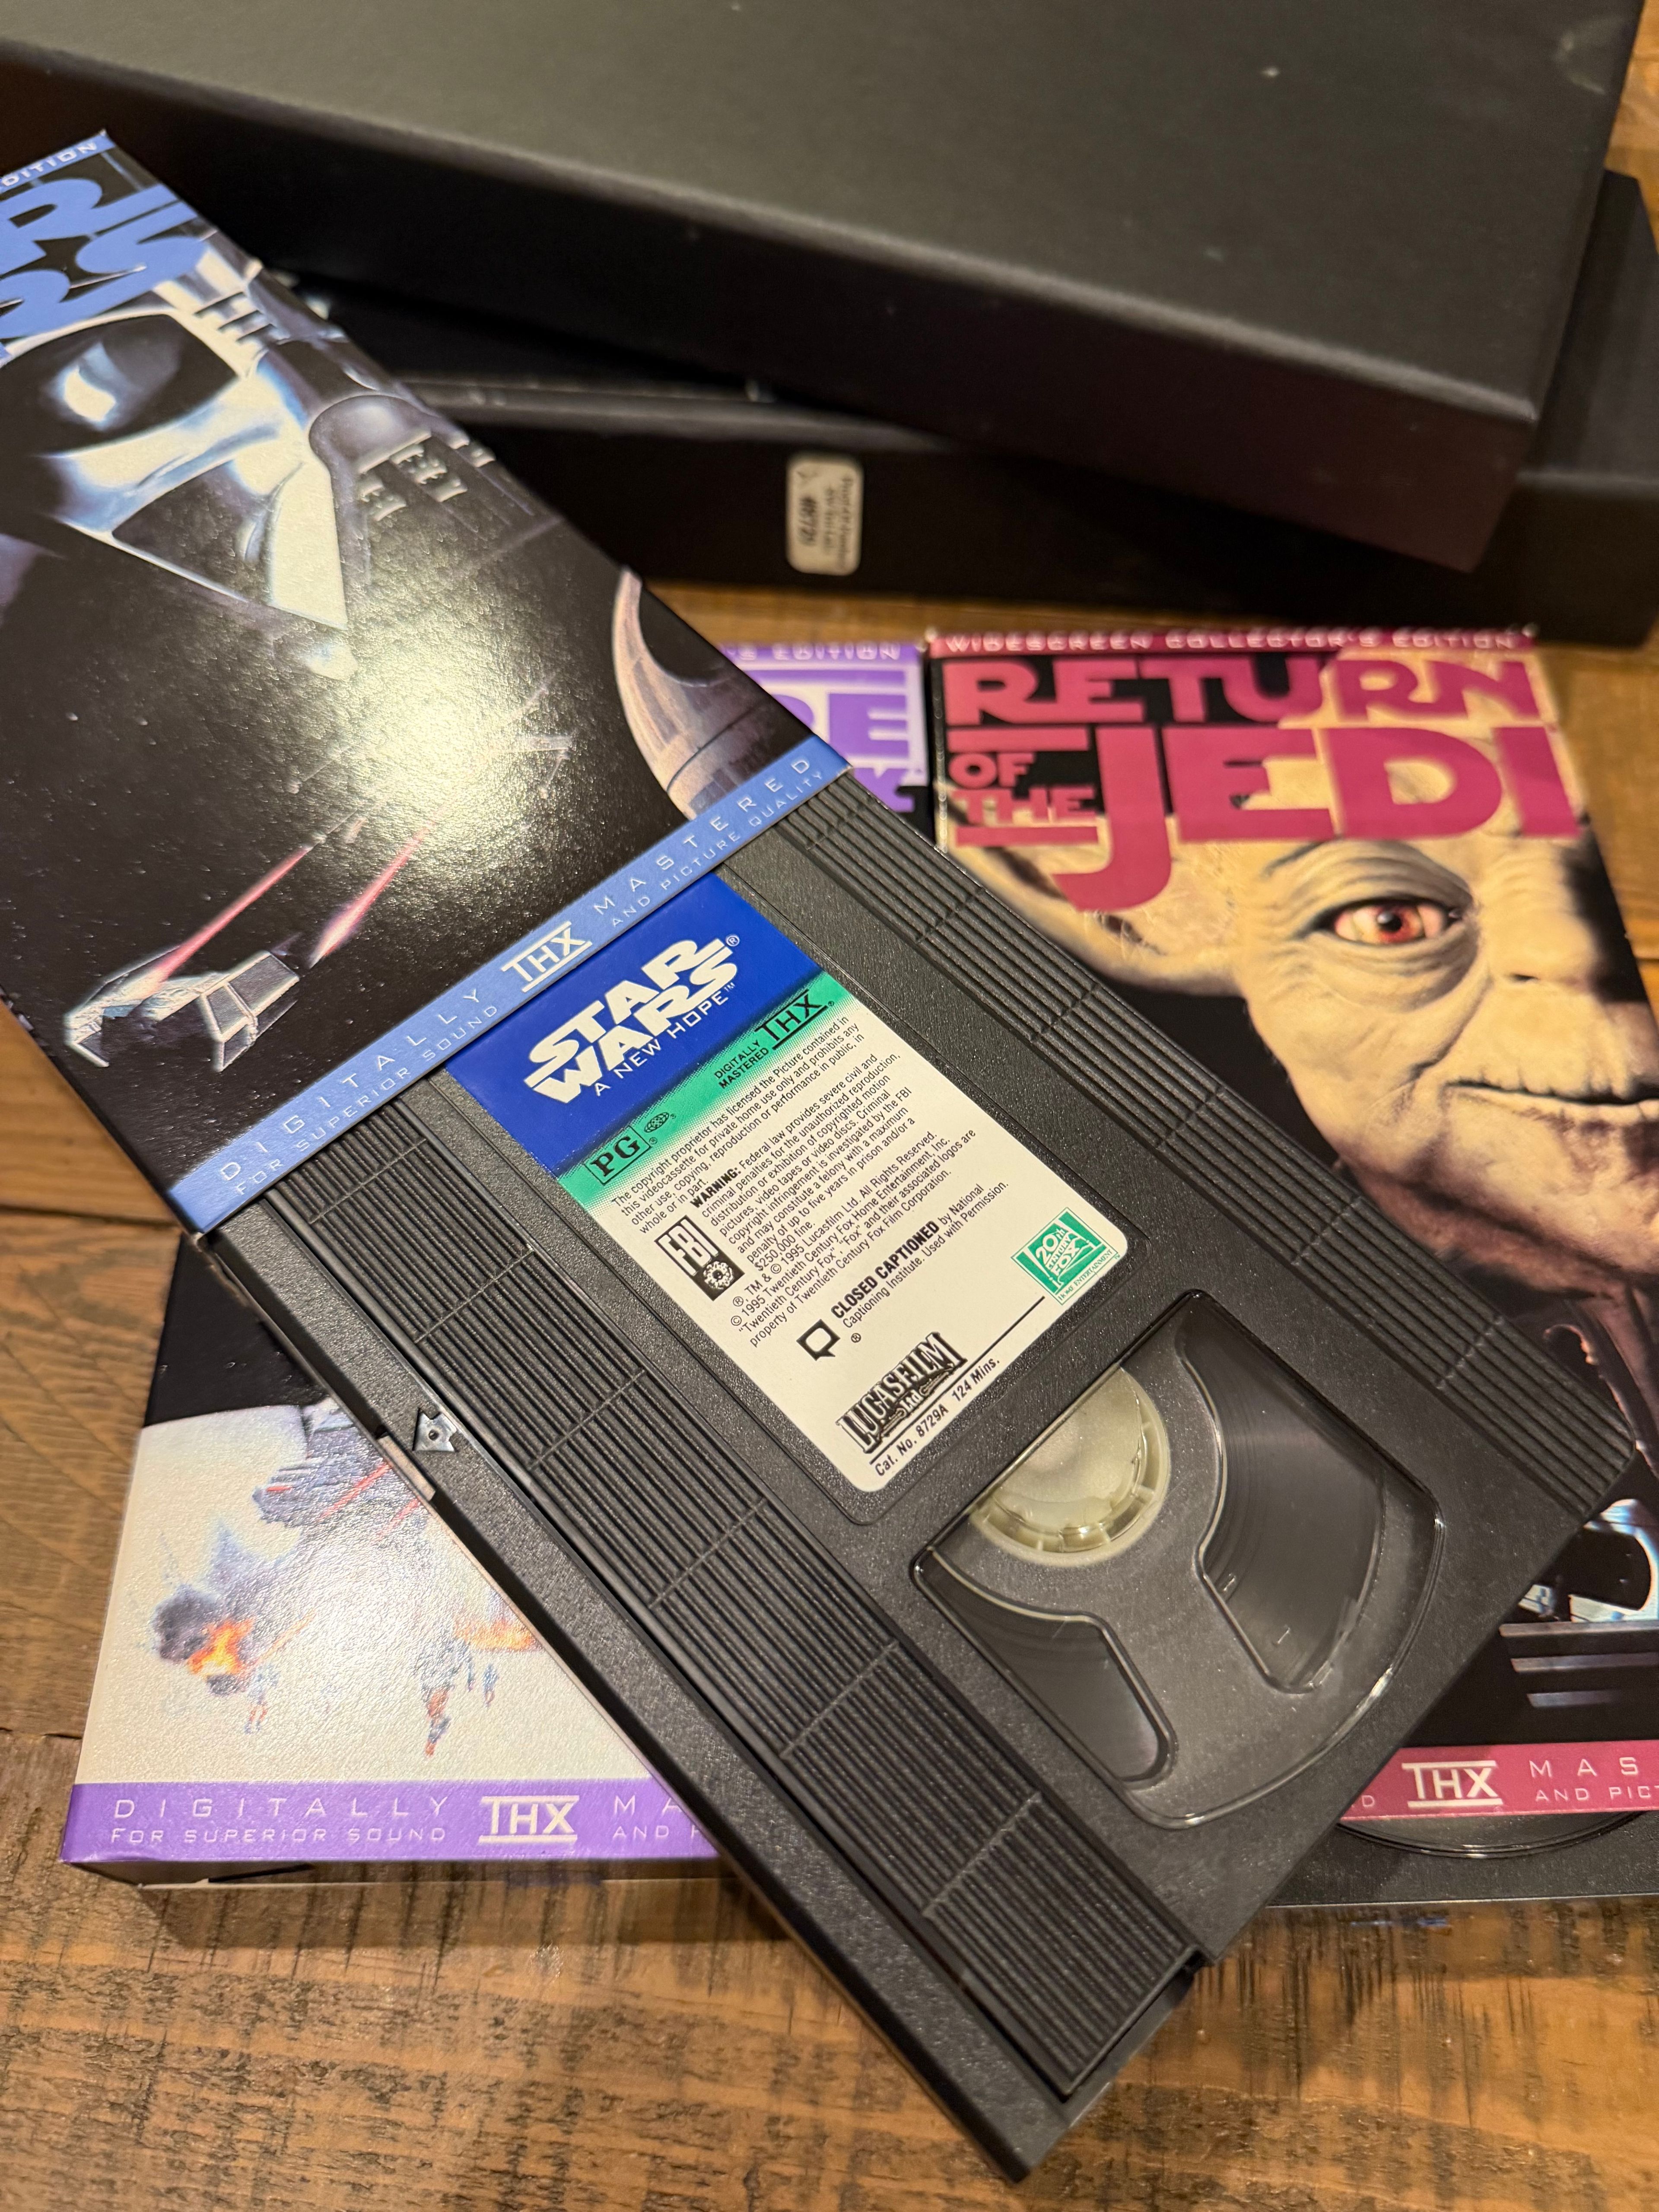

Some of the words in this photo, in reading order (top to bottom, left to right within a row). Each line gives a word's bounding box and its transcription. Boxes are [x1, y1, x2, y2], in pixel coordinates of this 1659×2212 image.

[943, 657, 1544, 726] RETURN
[946, 632, 1153, 652] WIDESCREEN
[1392, 629, 1516, 651] EDITION
[948, 752, 1034, 789] OF
[952, 785, 1097, 825] THE
[1052, 726, 1583, 911] JEDI
[220, 989, 479, 1181] DIGITALLY
[501, 921, 592, 993] THX
[593, 760, 811, 915] MASTERED
[235, 1158, 283, 1195] FOR
[296, 1067, 411, 1152] SUPERIOR
[422, 1005, 498, 1062] SOUND
[610, 896, 651, 928] AND
[659, 833, 741, 890] PICTURE
[748, 771, 823, 828] QUALITY
[523, 938, 725, 1088] STAR
[533, 946, 737, 1103] WARS
[753, 988, 828, 1050] THX
[594, 1082, 610, 1096] A
[613, 1039, 661, 1078] NEW
[610, 1192, 632, 1207] The
[630, 1158, 672, 1193] copyright
[670, 1125, 712, 1163] proprietor
[709, 1113, 728, 1128] has
[725, 1084, 762, 1116] licensed
[758, 1075, 775, 1089] the
[772, 1053, 804, 1078] Picture
[802, 1021, 840, 1055] contained
[836, 1017, 849, 1026] in
[621, 1200, 640, 1216] this
[639, 1155, 696, 1201] videocassette
[693, 1143, 709, 1157] for
[708, 1121, 738, 1148] private
[734, 1102, 762, 1124] home
[760, 1090, 777, 1104] use
[775, 1074, 795, 1092] only
[793, 1061, 810, 1077] and
[809, 1035, 844, 1066] prohibits
[842, 1023, 859, 1037] any
[714, 1040, 760, 1079] DIGITALLY
[718, 1048, 769, 1088] MASTERED
[590, 1136, 640, 1177] PG
[631, 1203, 655, 1225] other
[655, 1191, 676, 1206] use,
[674, 1161, 712, 1191] copying,
[709, 1118, 762, 1162] reproduction
[760, 1108, 771, 1119] or
[770, 1069, 821, 1113] performance
[817, 1062, 830, 1071] in
[828, 1042, 857, 1066] public,
[852, 1033, 864, 1043] in
[689, 1167, 741, 1208] WARNING:
[738, 1141, 771, 1170] Federal
[768, 1130, 786, 1145] law
[785, 1102, 820, 1135] provides
[818, 1081, 846, 1104] severe
[845, 1065, 862, 1083] civil
[861, 1053, 877, 1070] and
[701, 1186, 736, 1217] criminal
[735, 1157, 773, 1192] penalties
[770, 1146, 785, 1160] for
[783, 1135, 800, 1149] the
[798, 1092, 849, 1137] unauthorized
[848, 1054, 900, 1096] reproduction,
[710, 1185, 759, 1227] distribution
[757, 1176, 768, 1187] or
[767, 1144, 808, 1179] exhibition
[806, 1134, 817, 1146] of
[816, 1096, 863, 1138] copyrighted
[861, 1075, 890, 1100] motion
[719, 1205, 758, 1237] pictures,
[754, 1184, 779, 1204] video
[777, 1165, 802, 1186] tapes
[801, 1155, 812, 1166] or
[810, 1138, 835, 1158] video
[833, 1119, 859, 1139] discs.
[855, 1088, 891, 1119] Criminal
[728, 1208, 769, 1244] copyright
[765, 1166, 820, 1211] infringement
[816, 1159, 828, 1169] is
[826, 1118, 874, 1161] investigated
[871, 1110, 885, 1122] by
[882, 1100, 898, 1113] the
[895, 1086, 912, 1102] FBI
[737, 1235, 755, 1253] and
[753, 1220, 774, 1239] may
[772, 1187, 814, 1223] constitute
[818, 1160, 847, 1183] felony
[843, 1145, 864, 1162] with
[868, 1107, 909, 1142] maximum
[657, 1218, 719, 1276] FBI
[741, 1294, 766, 1316] 1995
[762, 1261, 807, 1297] Twentieth
[804, 1232, 839, 1262] Century
[835, 1218, 855, 1235] Fox
[851, 1198, 879, 1221] Home
[875, 1150, 935, 1200] Entertainment,
[930, 1138, 950, 1152] Inc.
[746, 1233, 779, 1264] penalty
[777, 1224, 788, 1236] of
[787, 1216, 800, 1227] up
[798, 1207, 810, 1217] to
[807, 1193, 826, 1209] five
[823, 1174, 849, 1198] years
[846, 1166, 858, 1176] in
[856, 1145, 883, 1170] prison
[881, 1122, 908, 1147] and/or
[754, 1234, 796, 1271] $250,000
[793, 1221, 815, 1237] fine.
[830, 1275, 878, 1319] CLOSED
[874, 1220, 940, 1279] CAPTIONED
[937, 1212, 953, 1225] by
[948, 1183, 984, 1215] National
[1035, 1228, 1066, 1265] 20th
[1046, 1234, 1072, 1270] CENTURY
[749, 1311, 787, 1348] property
[786, 1300, 798, 1314] of
[794, 1267, 838, 1303] Twentieth
[835, 1239, 870, 1269] Century
[866, 1225, 886, 1241] Fox
[882, 1209, 904, 1227] Film
[900, 1170, 951, 1211] Corporation.
[842, 1287, 890, 1328] Captioning
[885, 1257, 925, 1289] Institute.
[921, 1234, 946, 1257] Used
[943, 1220, 963, 1238] with
[960, 1182, 1008, 1222] Permission.
[1052, 1239, 1079, 1275] FOX
[835, 1331, 967, 1454] LUCASFILM
[874, 1454, 898, 1476] Cat.
[896, 1438, 917, 1456] No.
[915, 1404, 949, 1437] 8729A
[951, 1379, 972, 1402] 124
[969, 1358, 1000, 1384] Mins.
[111, 1827, 164, 1844] FOR
[183, 1828, 327, 1843] SUPERIOR
[347, 1827, 446, 1844] SOUND
[612, 1824, 670, 1841] AND
[114, 1796, 448, 1818] DIGITALLY
[478, 1794, 580, 1844] THX
[1401, 1760, 1503, 1808] THX
[1535, 1788, 1589, 1802] AND
